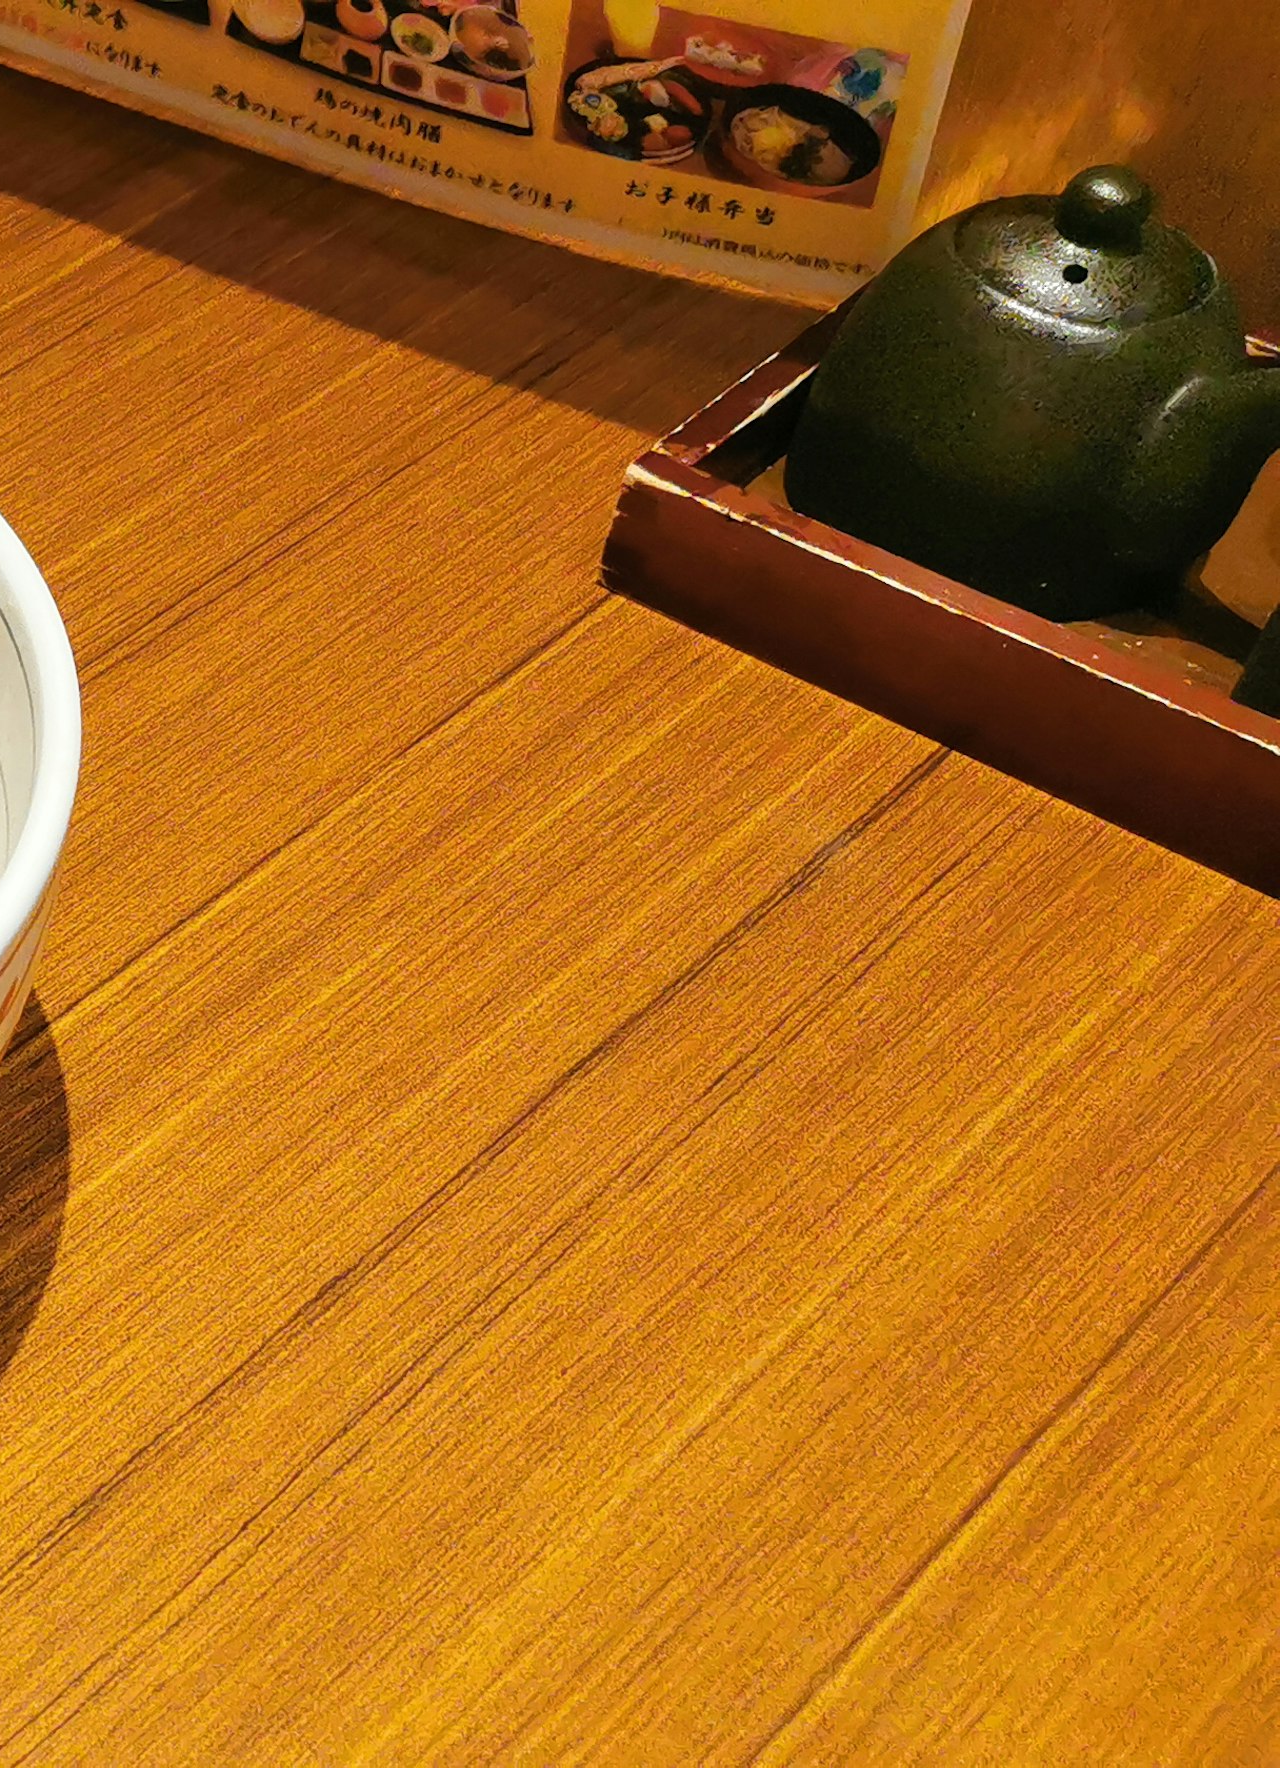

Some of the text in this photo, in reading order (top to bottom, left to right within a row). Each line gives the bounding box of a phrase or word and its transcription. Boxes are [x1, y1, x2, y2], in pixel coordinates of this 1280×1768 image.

[624, 179, 776, 226] お子様弁当
